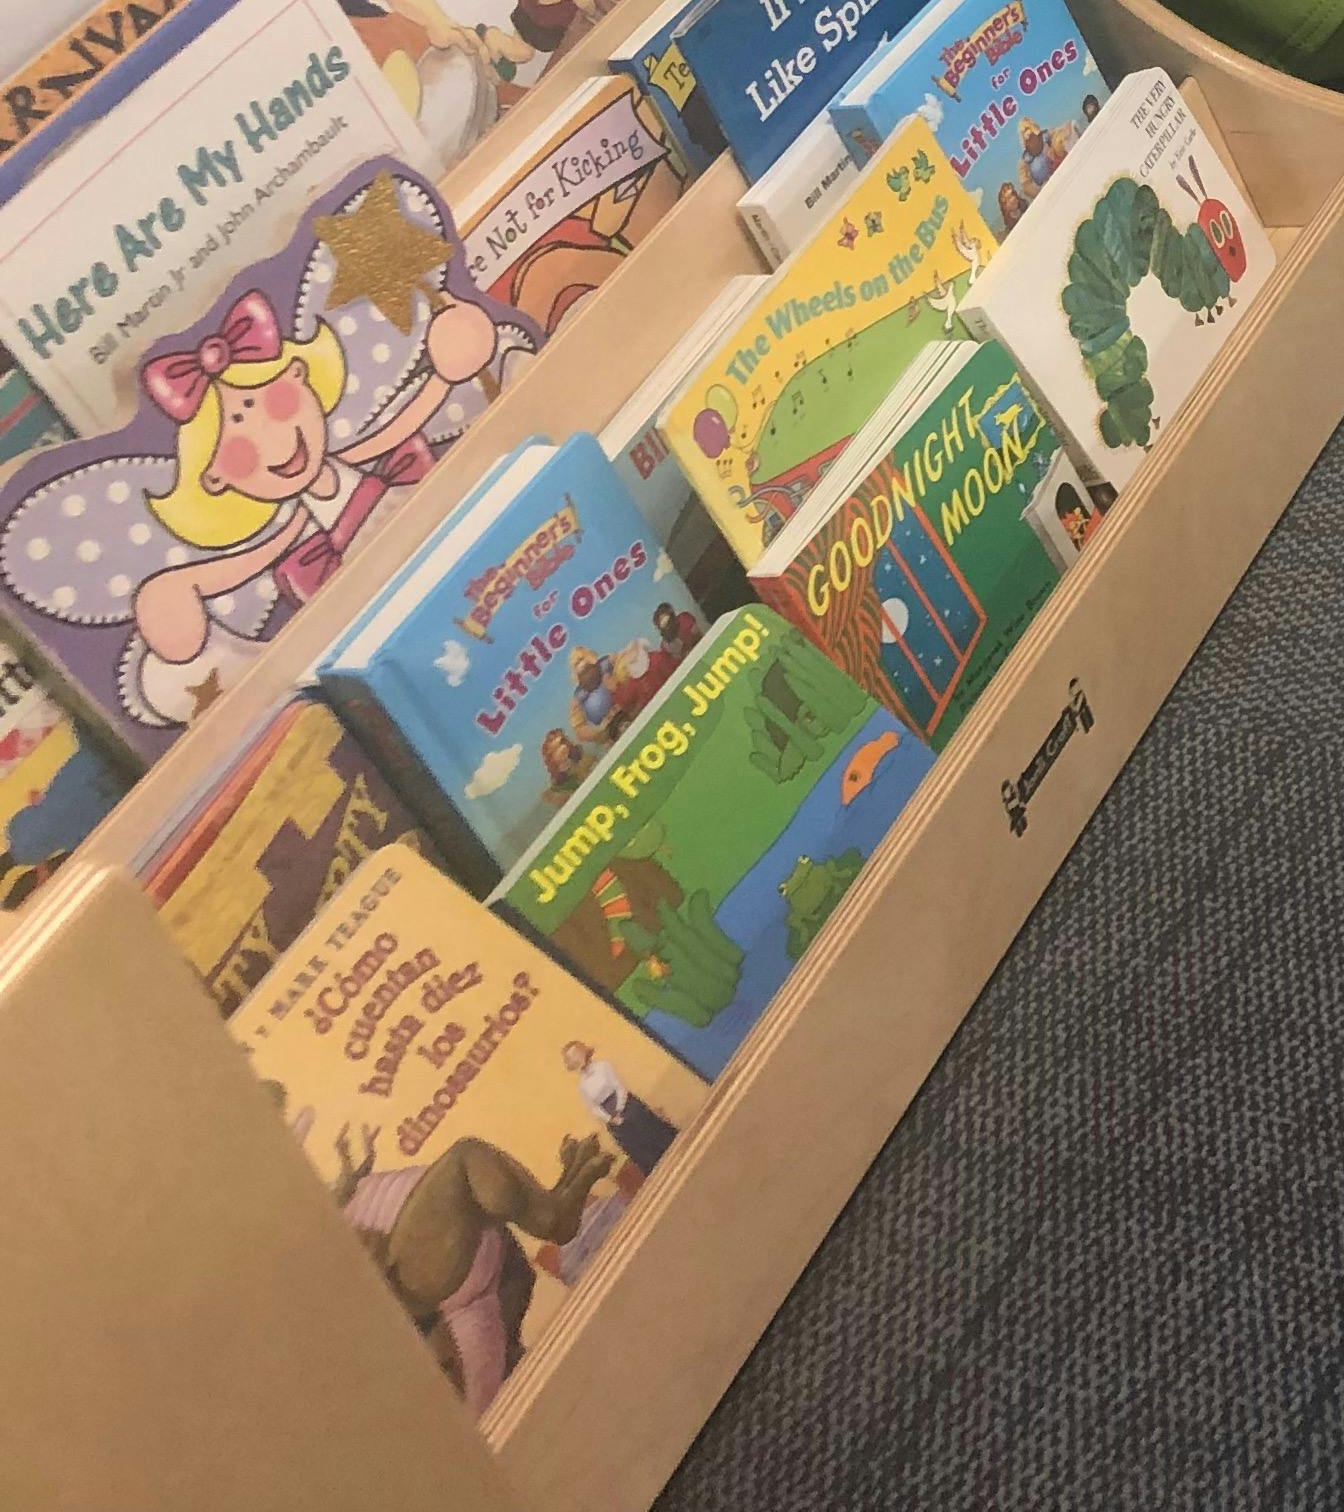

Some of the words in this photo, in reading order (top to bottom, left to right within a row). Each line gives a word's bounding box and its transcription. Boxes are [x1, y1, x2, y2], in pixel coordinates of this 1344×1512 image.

[745, 46, 818, 124] Like
[944, 4, 1020, 89] Beginner's
[991, 68, 1010, 90] for
[950, 95, 1018, 178] Little
[1018, 40, 1078, 96] Ones
[1129, 102, 1151, 129] THE
[1139, 108, 1187, 178] CATERPILLAR
[17, 261, 119, 360] Here
[113, 197, 186, 273] Are
[177, 140, 243, 206] My
[234, 46, 350, 153] Hands
[190, 234, 220, 270] and
[221, 202, 256, 246] John
[486, 204, 528, 261] Not
[525, 185, 555, 219] for
[552, 130, 645, 199] Kicking
[804, 186, 823, 209] Bill
[725, 333, 771, 385] The
[765, 280, 857, 340] Wheels
[859, 273, 889, 302] on
[888, 243, 924, 286] the
[915, 194, 949, 250] Bus
[807, 385, 977, 617] GOODNIGHT
[940, 415, 1026, 546] MOON
[469, 512, 572, 627] Beginner's
[476, 623, 569, 737] Little
[569, 539, 649, 618] Ones
[529, 804, 631, 904] Jump,
[610, 720, 697, 798] Frog,
[682, 613, 770, 717] Jump!
[325, 867, 403, 952] TEAGUE
[344, 948, 441, 1061] cuentan
[358, 1015, 425, 1098] hasta
[421, 961, 484, 1014] diez
[416, 1022, 466, 1070] los
[397, 971, 541, 1157] dinosaurios?
